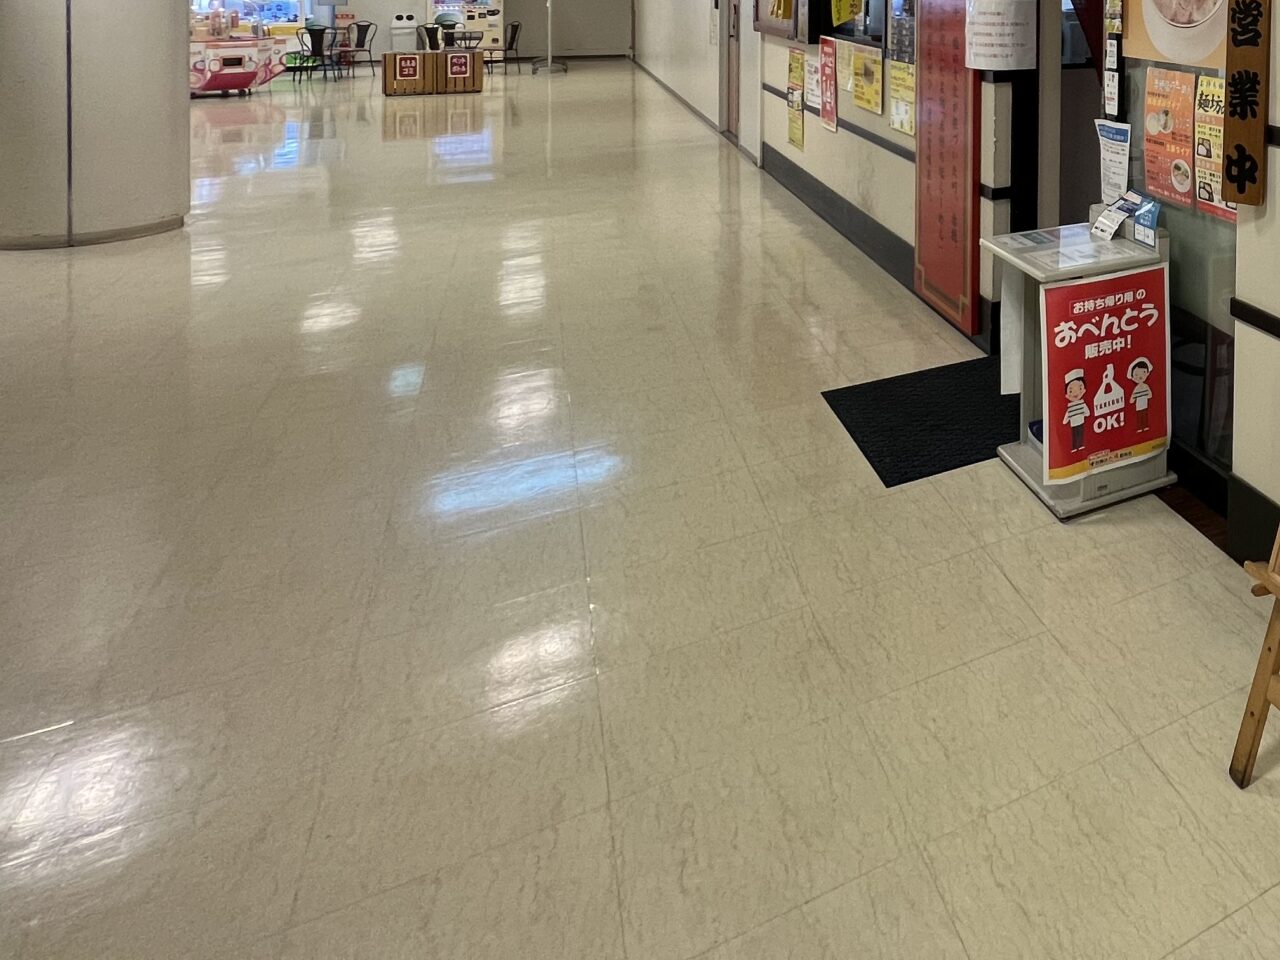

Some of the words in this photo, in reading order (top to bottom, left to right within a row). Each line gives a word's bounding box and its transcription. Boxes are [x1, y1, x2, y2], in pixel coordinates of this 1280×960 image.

[1226, 0, 1264, 195] 営業中
[1054, 303, 1160, 348] おべんとう
[1085, 334, 1132, 360] 販売中！
[1093, 411, 1125, 434] OK!
